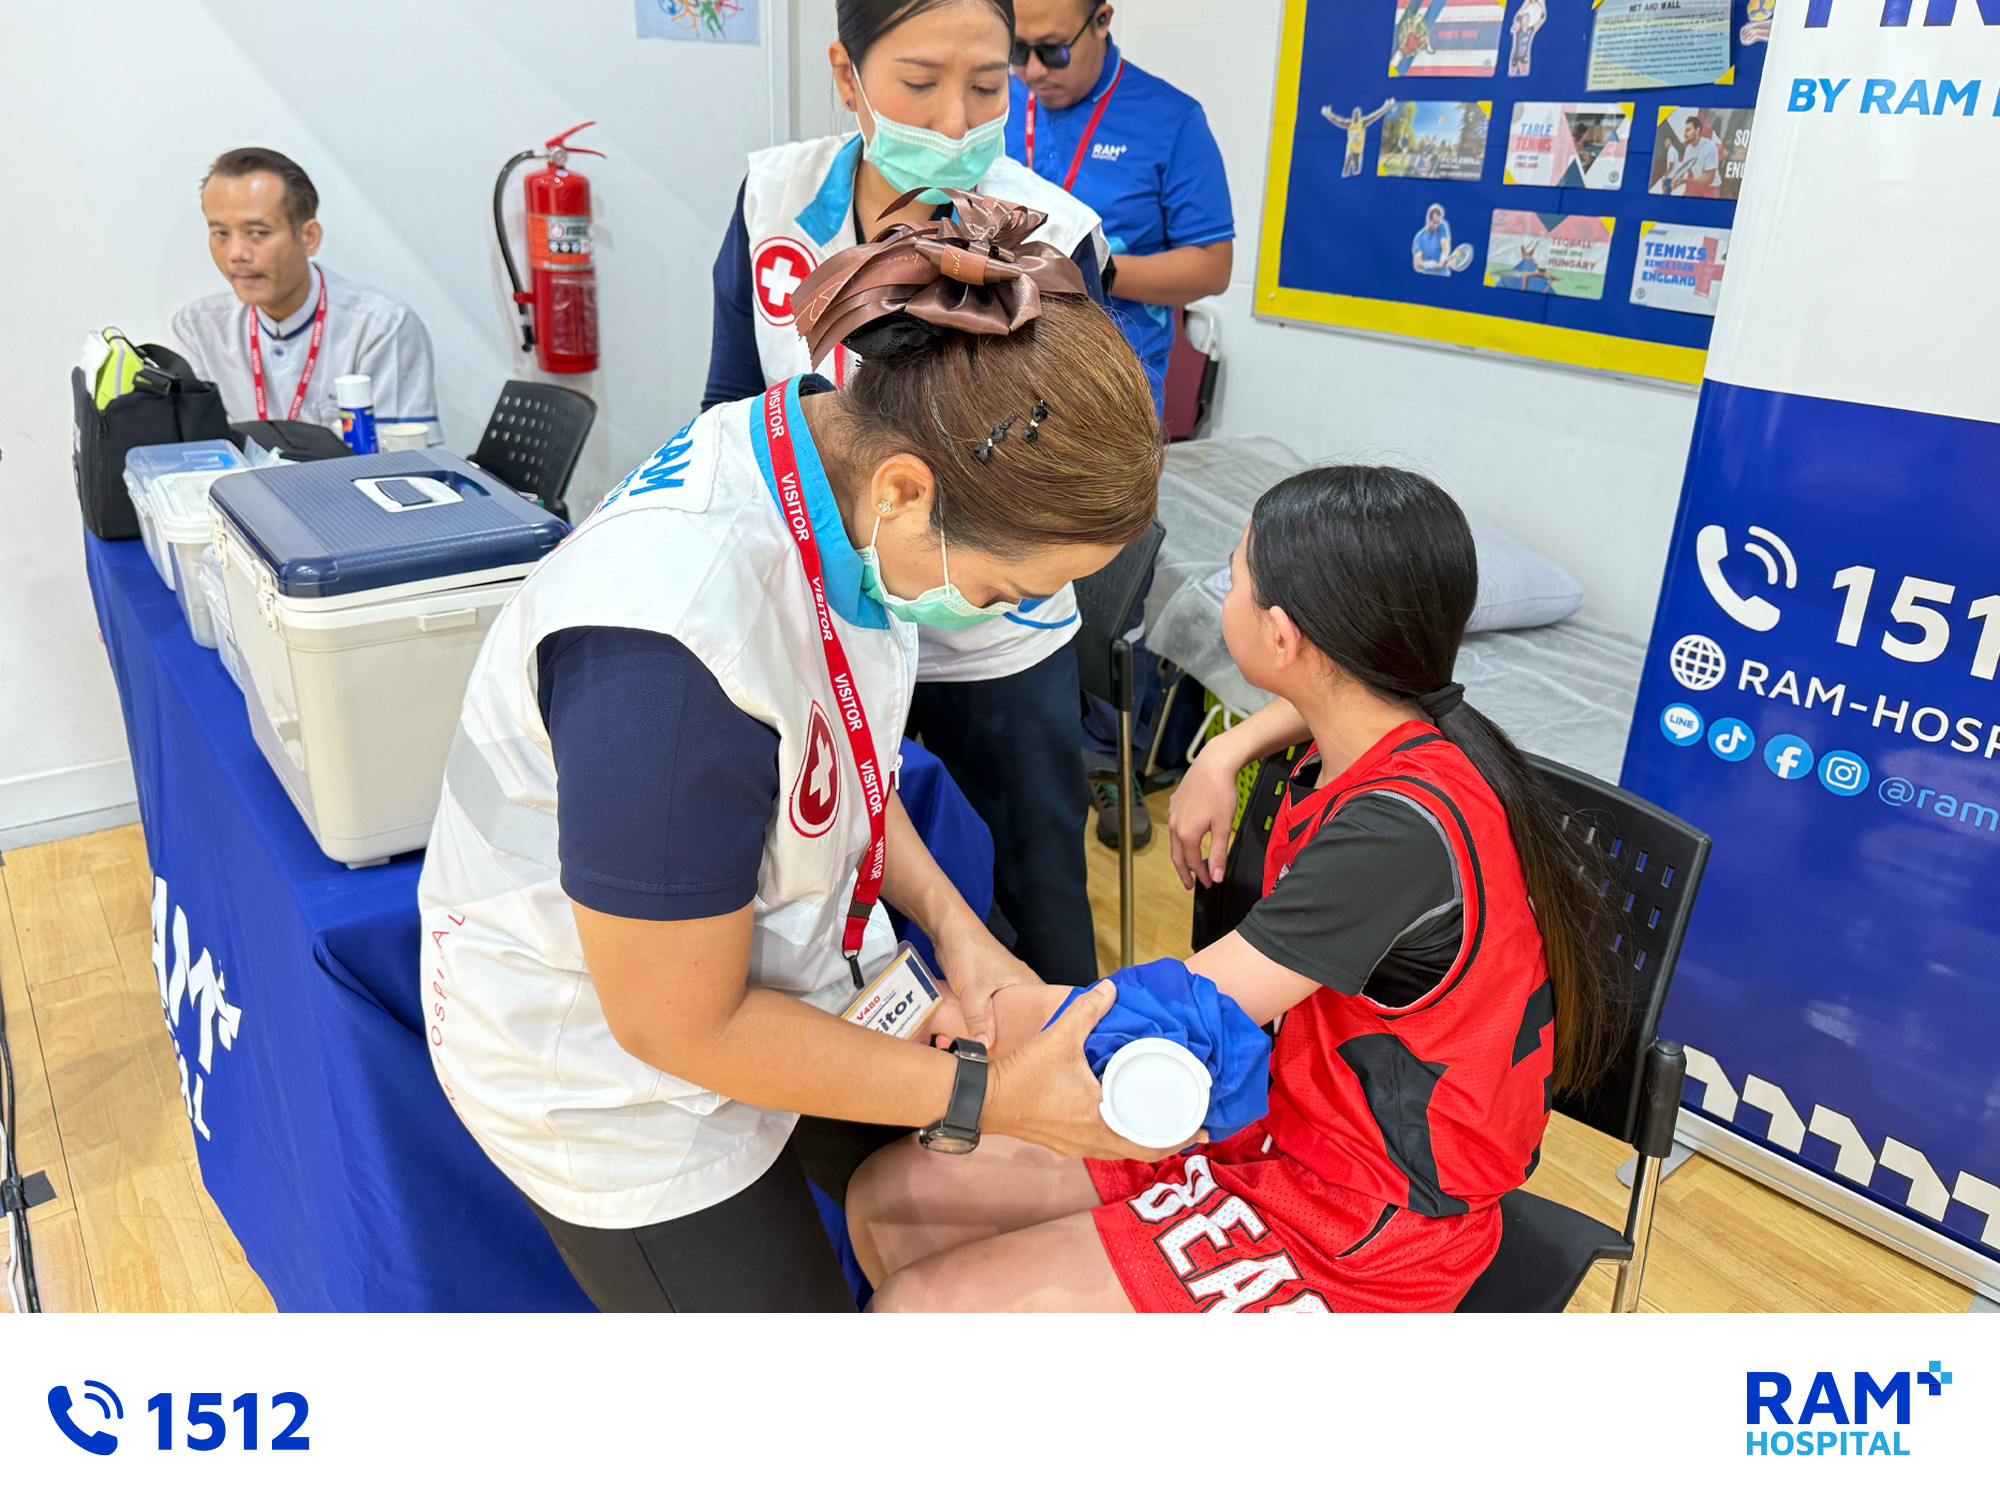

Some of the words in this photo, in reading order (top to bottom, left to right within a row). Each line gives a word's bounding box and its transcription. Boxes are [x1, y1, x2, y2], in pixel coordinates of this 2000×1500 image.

[1661, 0, 1681, 10] WALL
[1787, 78, 1850, 113] BY
[1859, 79, 1981, 116] RAM
[1515, 137, 1553, 152] TENNIS
[1521, 123, 1553, 137] TABLE
[1552, 237, 1592, 249] TEQBALL
[1645, 242, 1707, 261] TENNIS
[1548, 258, 1596, 271] HUNGARY
[1642, 271, 1696, 287] ENGLAND
[769, 386, 785, 439] VISITOR
[781, 472, 810, 542] VISITOR
[812, 577, 833, 641] VISITOR
[834, 672, 863, 732] VISITOR
[1670, 714, 1694, 730] LINE
[859, 759, 883, 817] VISITOR
[1878, 777, 2000, 832] @ram
[870, 836, 884, 881] VISITOR
[877, 990, 914, 1032] itor
